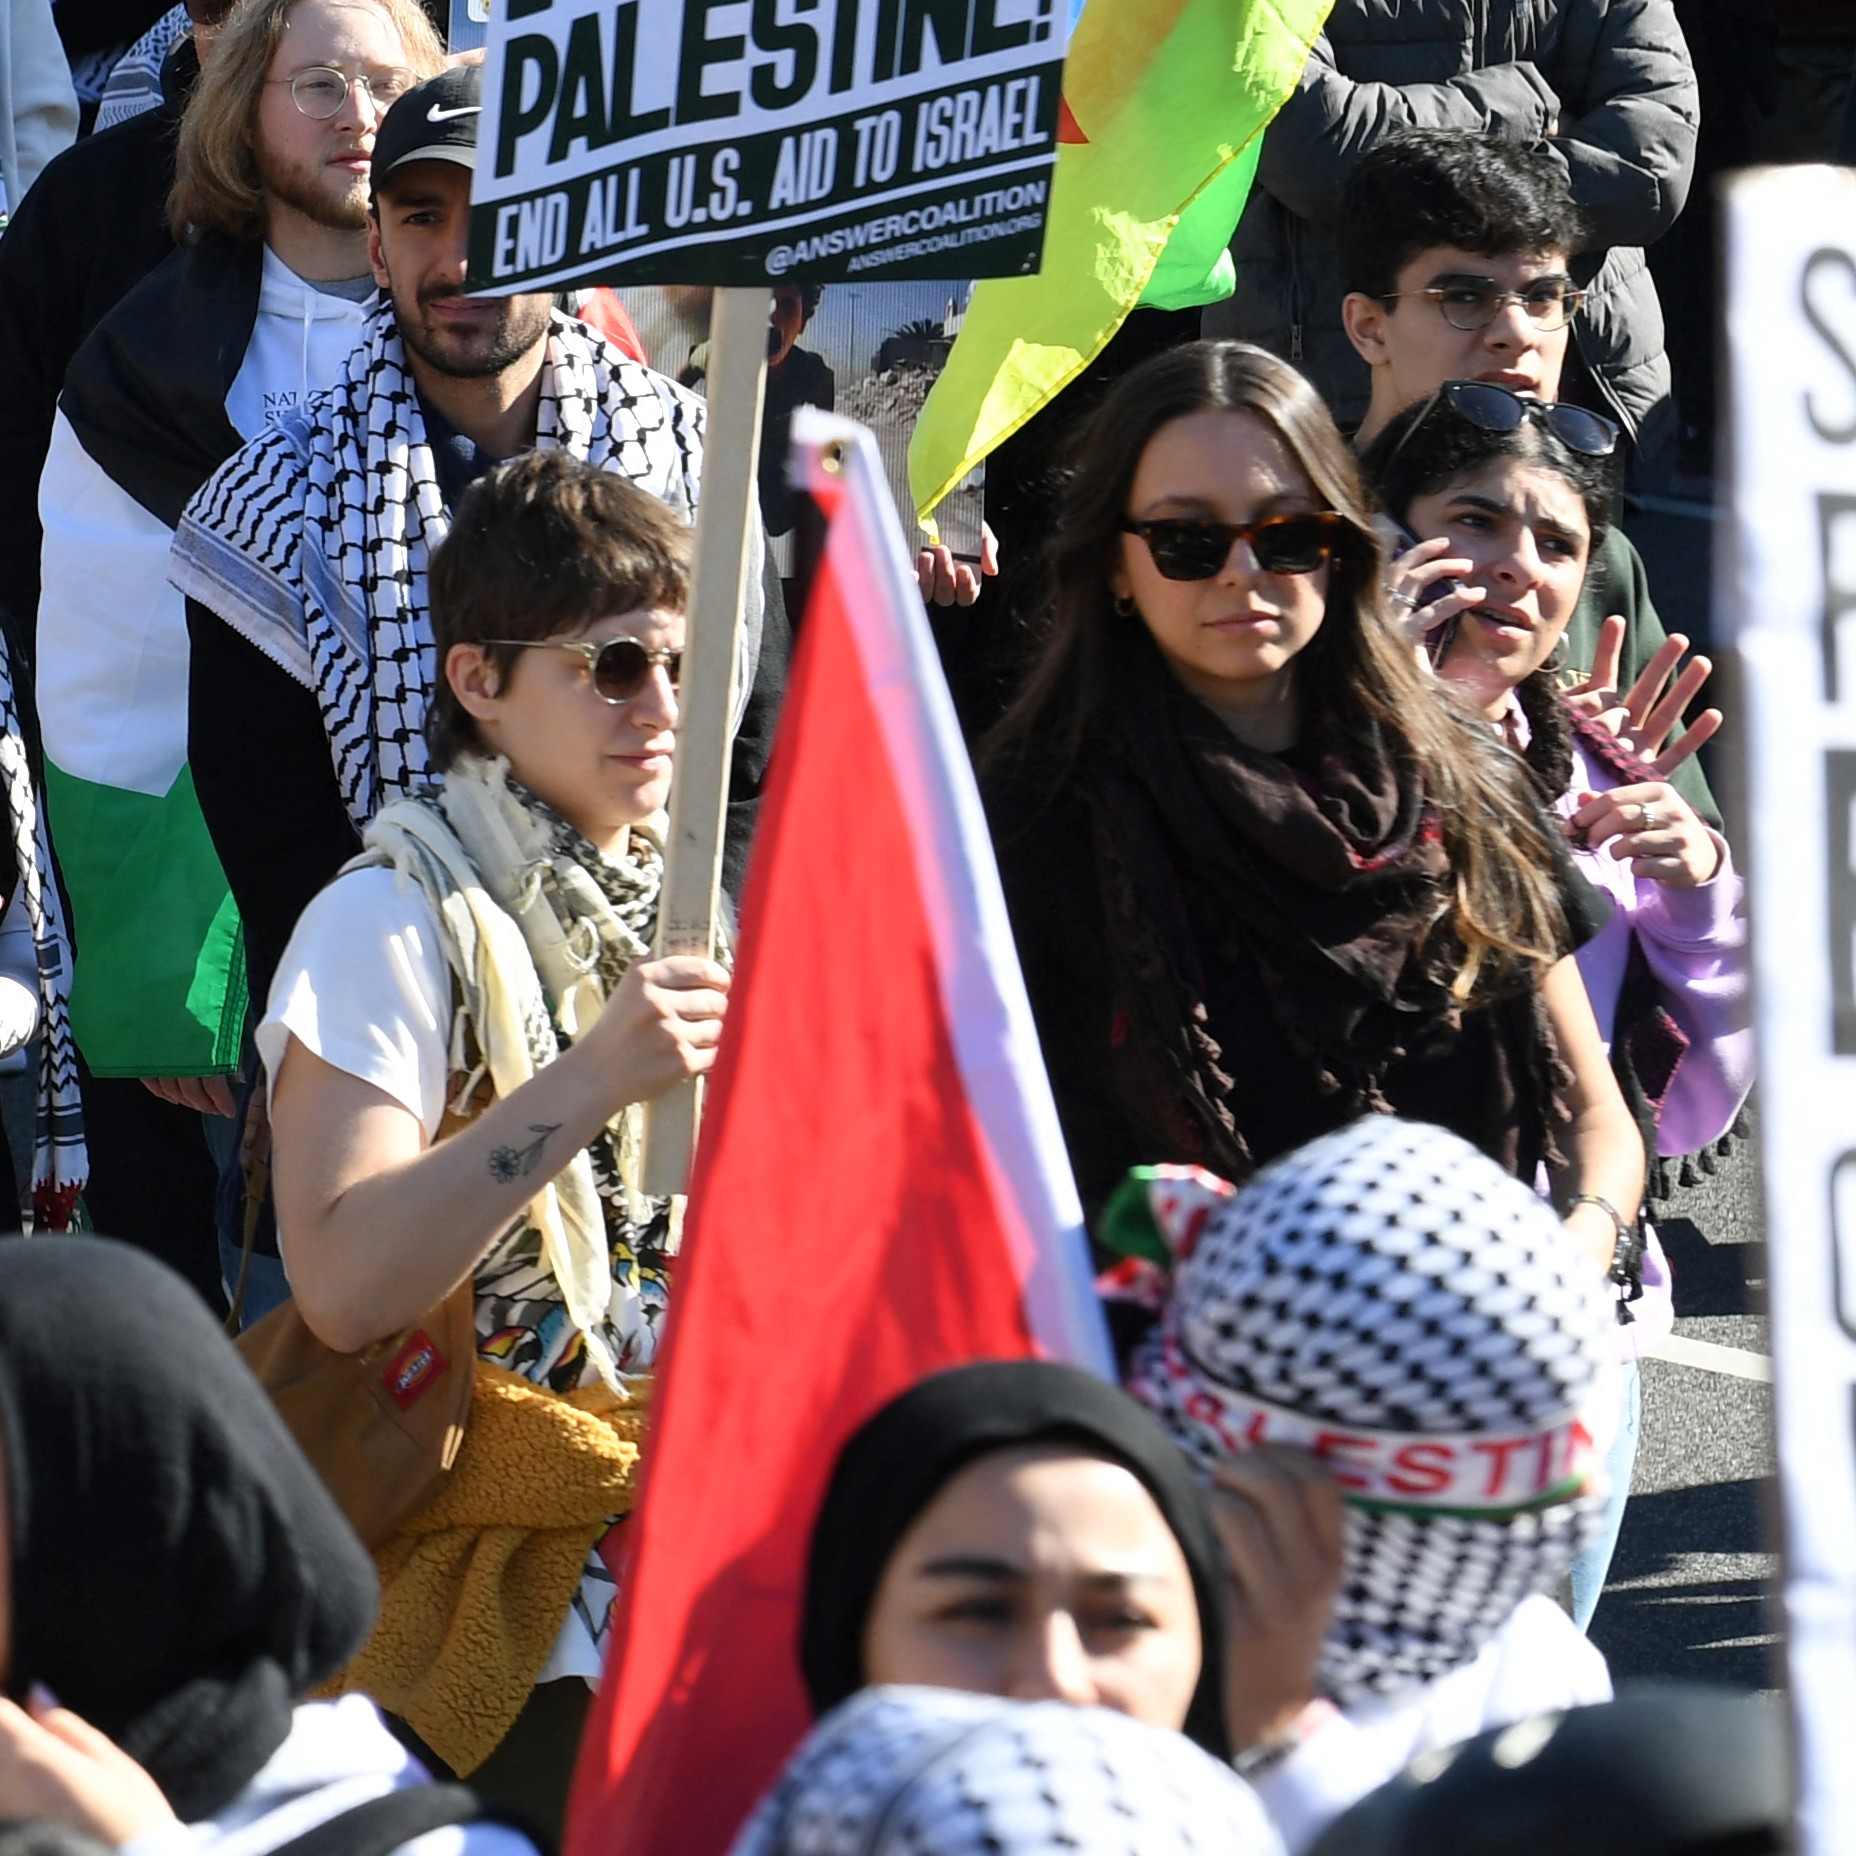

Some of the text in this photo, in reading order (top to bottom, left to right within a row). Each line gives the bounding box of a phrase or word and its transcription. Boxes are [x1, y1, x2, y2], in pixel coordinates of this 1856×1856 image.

[492, 76, 1049, 279] END ALL U.S. AID TO ISRAEL
[765, 180, 1048, 275] @ANSWERCOALITION
[847, 213, 1042, 274] ANSWERCOALITION.ORG
